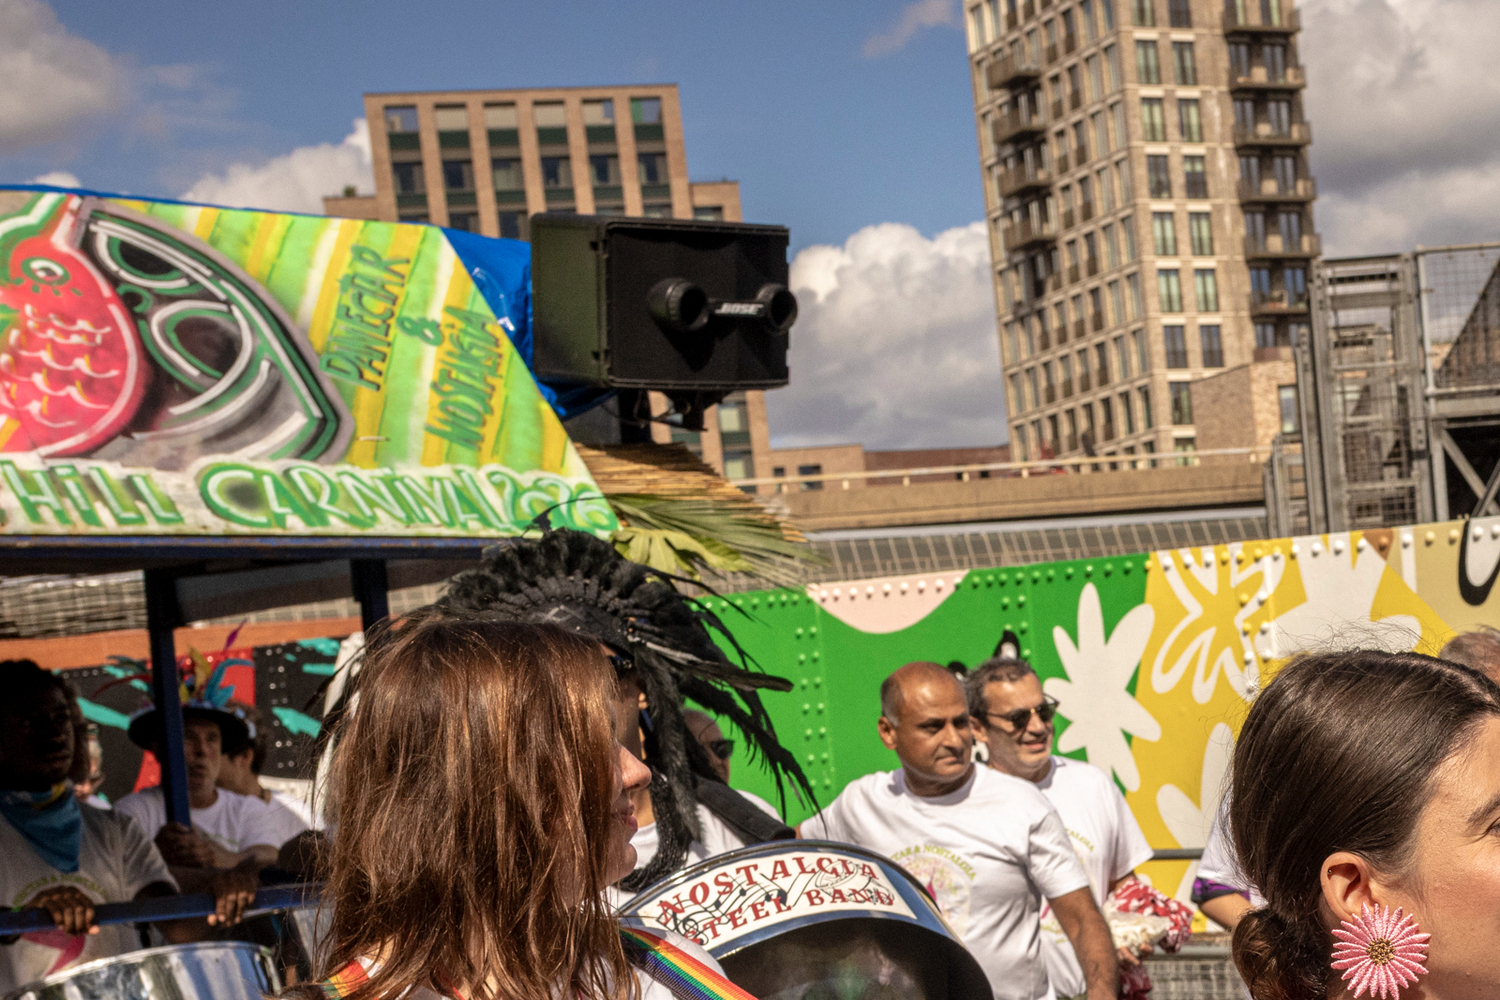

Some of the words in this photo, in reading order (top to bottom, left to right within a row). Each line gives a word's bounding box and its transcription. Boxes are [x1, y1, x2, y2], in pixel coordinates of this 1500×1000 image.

[714, 302, 764, 315] BOSE
[656, 856, 880, 926] NOSTALGIA
[684, 896, 793, 945] STEEL
[804, 888, 894, 907] BAND
